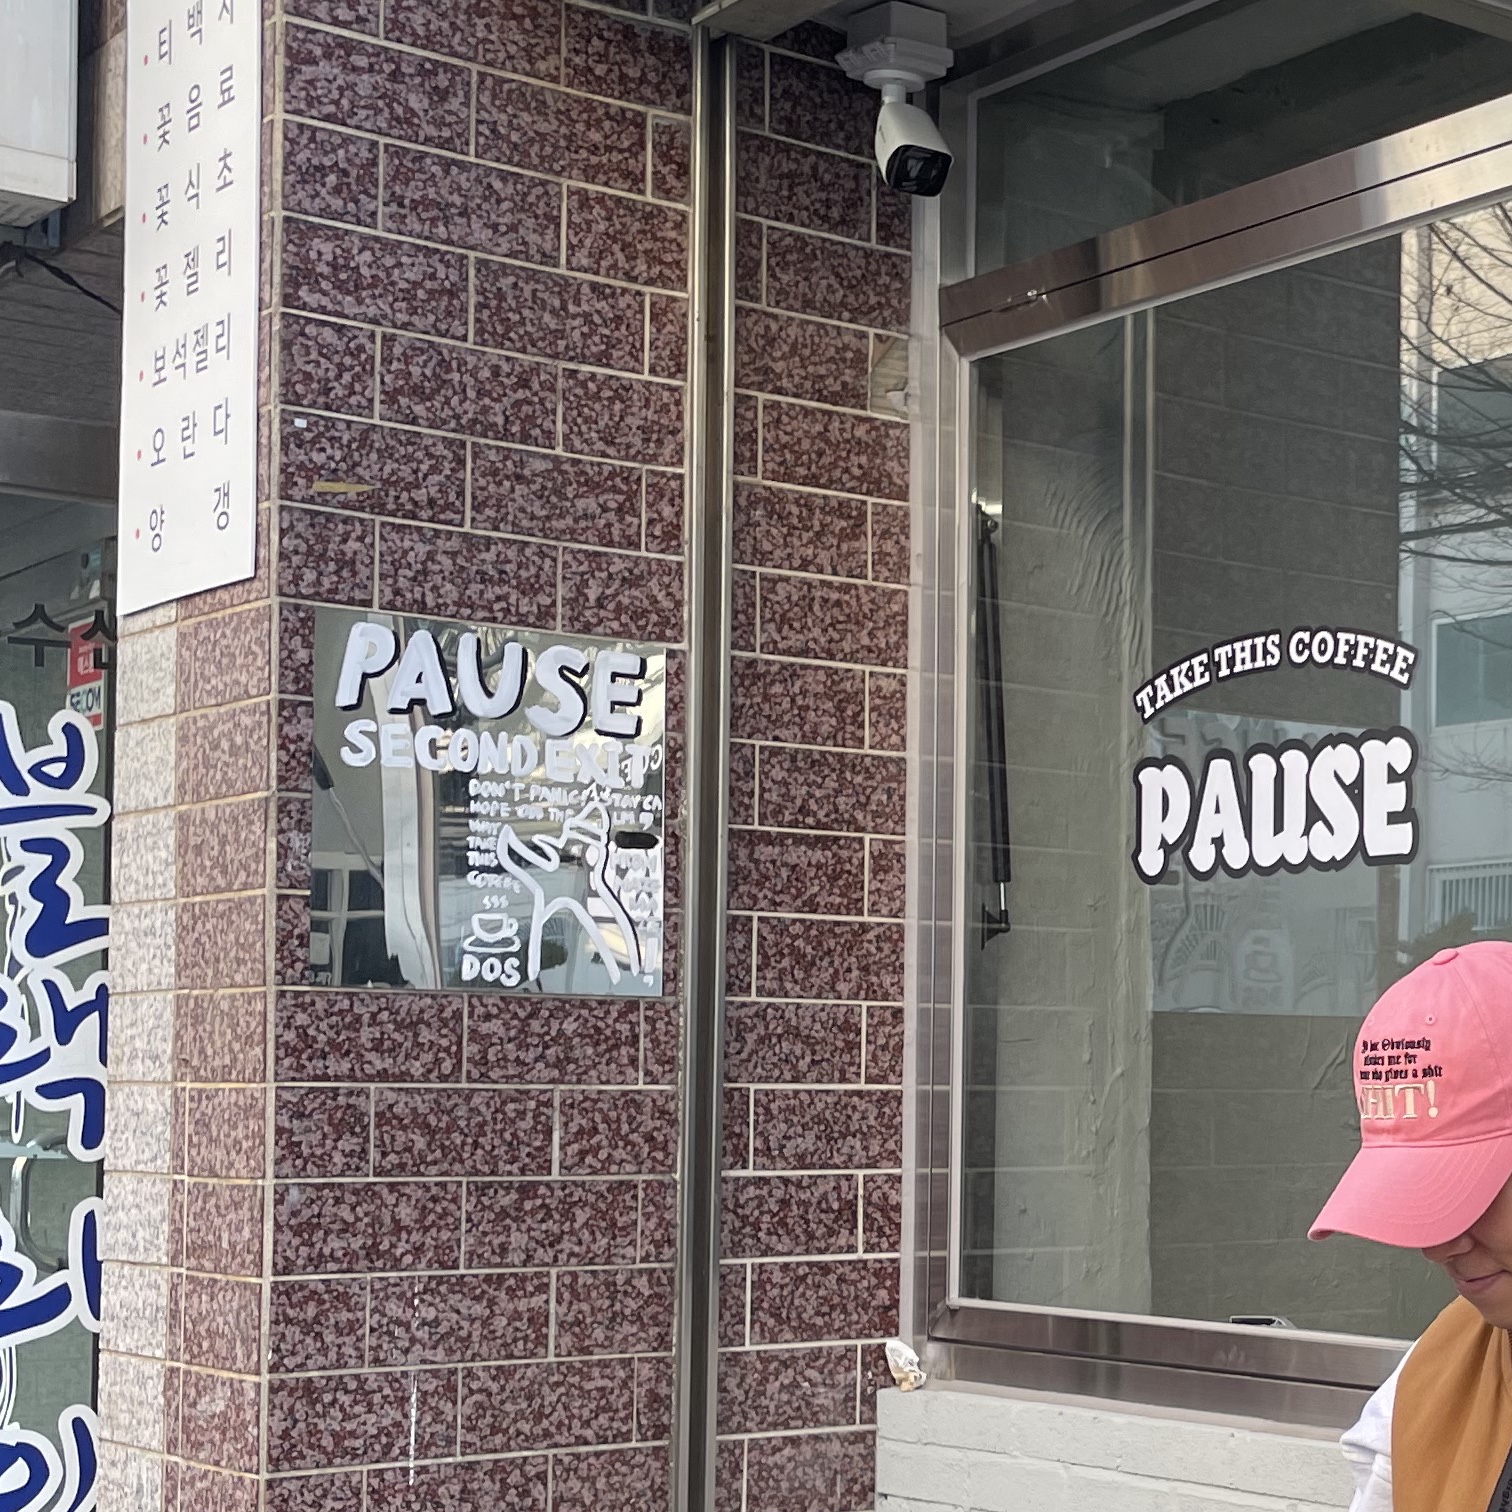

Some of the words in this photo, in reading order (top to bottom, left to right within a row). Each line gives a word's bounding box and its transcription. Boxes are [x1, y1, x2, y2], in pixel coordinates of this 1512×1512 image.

[151, 313, 232, 388] 보석젤리
[335, 621, 647, 739] PAUSE
[1135, 652, 1212, 721] TAKE
[1214, 632, 1281, 679] THIS
[1288, 630, 1416, 685] COFFEE
[340, 719, 538, 776] SECOND
[545, 739, 652, 788] EXIT
[1135, 730, 1416, 880] PAUSE
[462, 953, 521, 987] DOS
